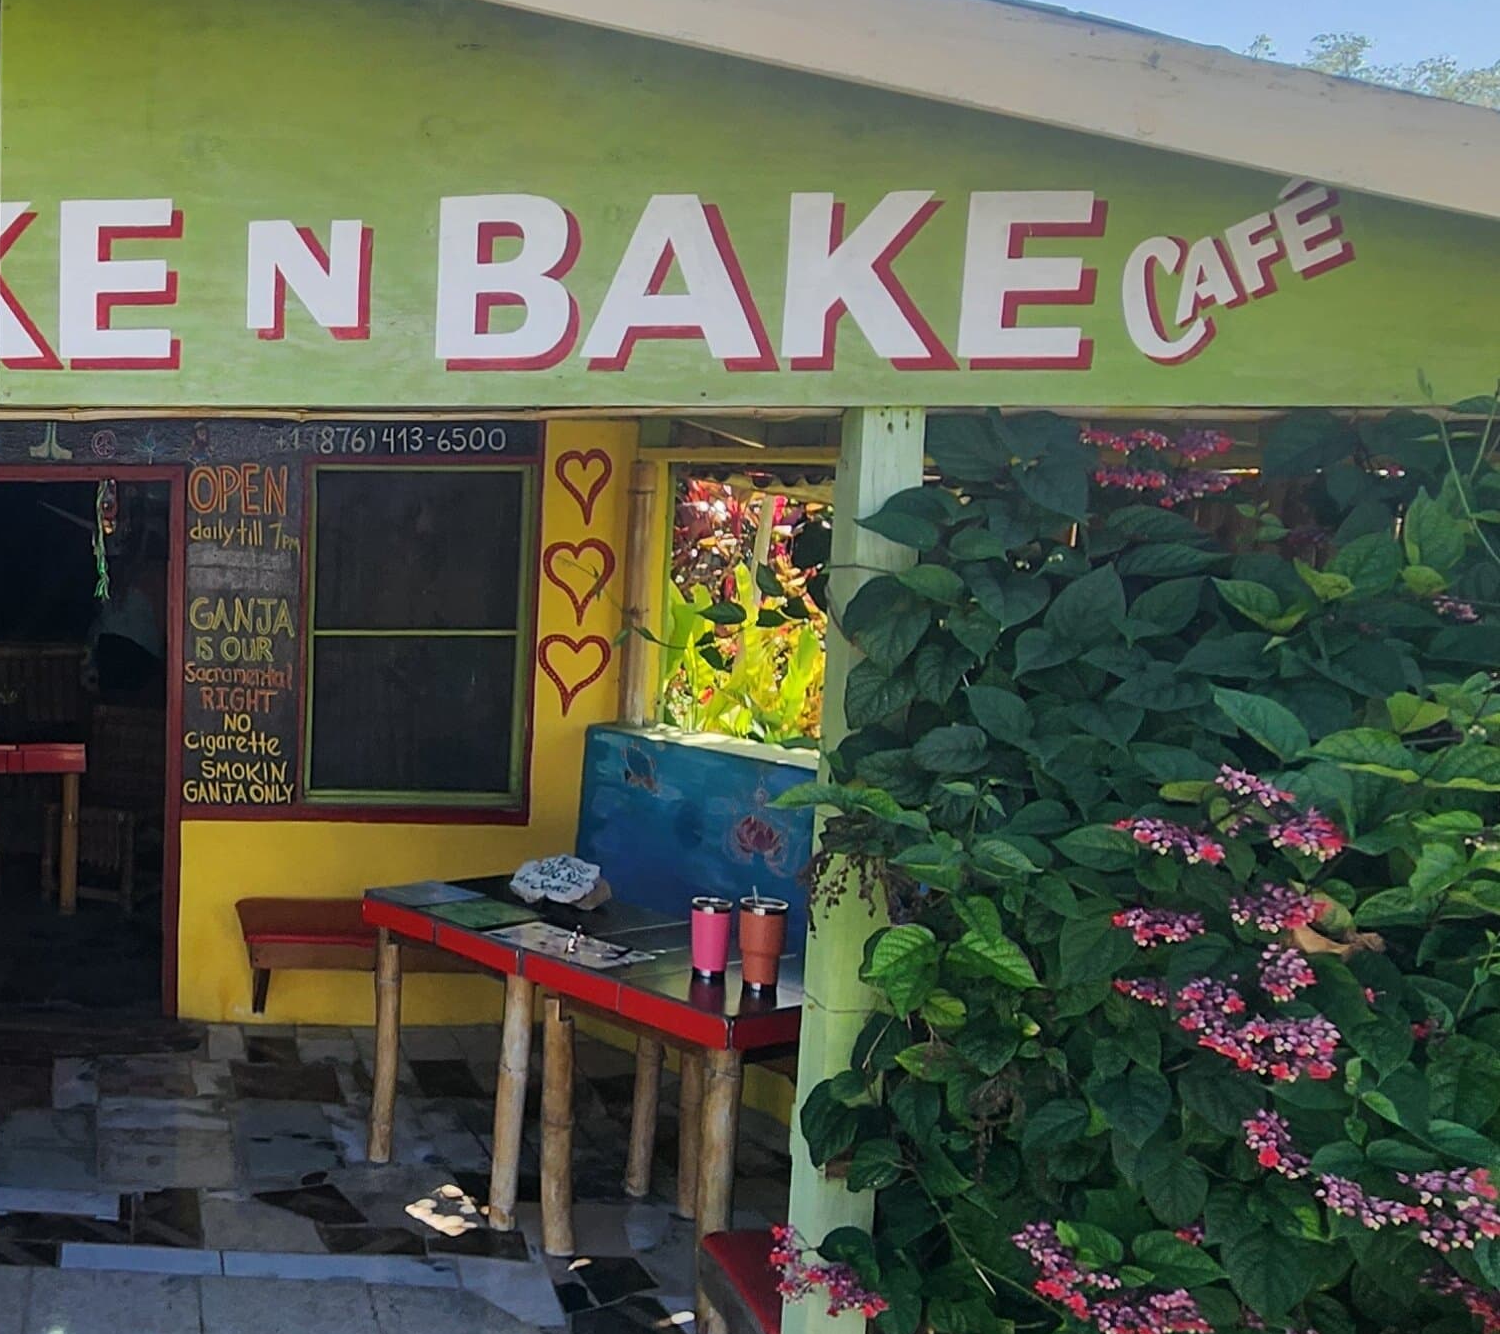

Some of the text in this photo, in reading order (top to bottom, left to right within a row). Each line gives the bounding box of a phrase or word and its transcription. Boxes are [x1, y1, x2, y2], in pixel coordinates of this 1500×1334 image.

[246, 219, 374, 341] N
[435, 190, 1109, 372] BAKE
[381, 426, 507, 455] 413-6500
[187, 463, 288, 516] OPEN
[189, 518, 235, 548] daily
[236, 518, 263, 547] till
[189, 596, 295, 638] GANJA
[195, 636, 275, 662] IS OUR
[184, 661, 293, 691] Sacramental
[200, 686, 278, 714] RIGHT
[223, 713, 252, 733] NO
[201, 760, 288, 785] SMOKIN
[183, 780, 295, 805] GANJA ONLY
